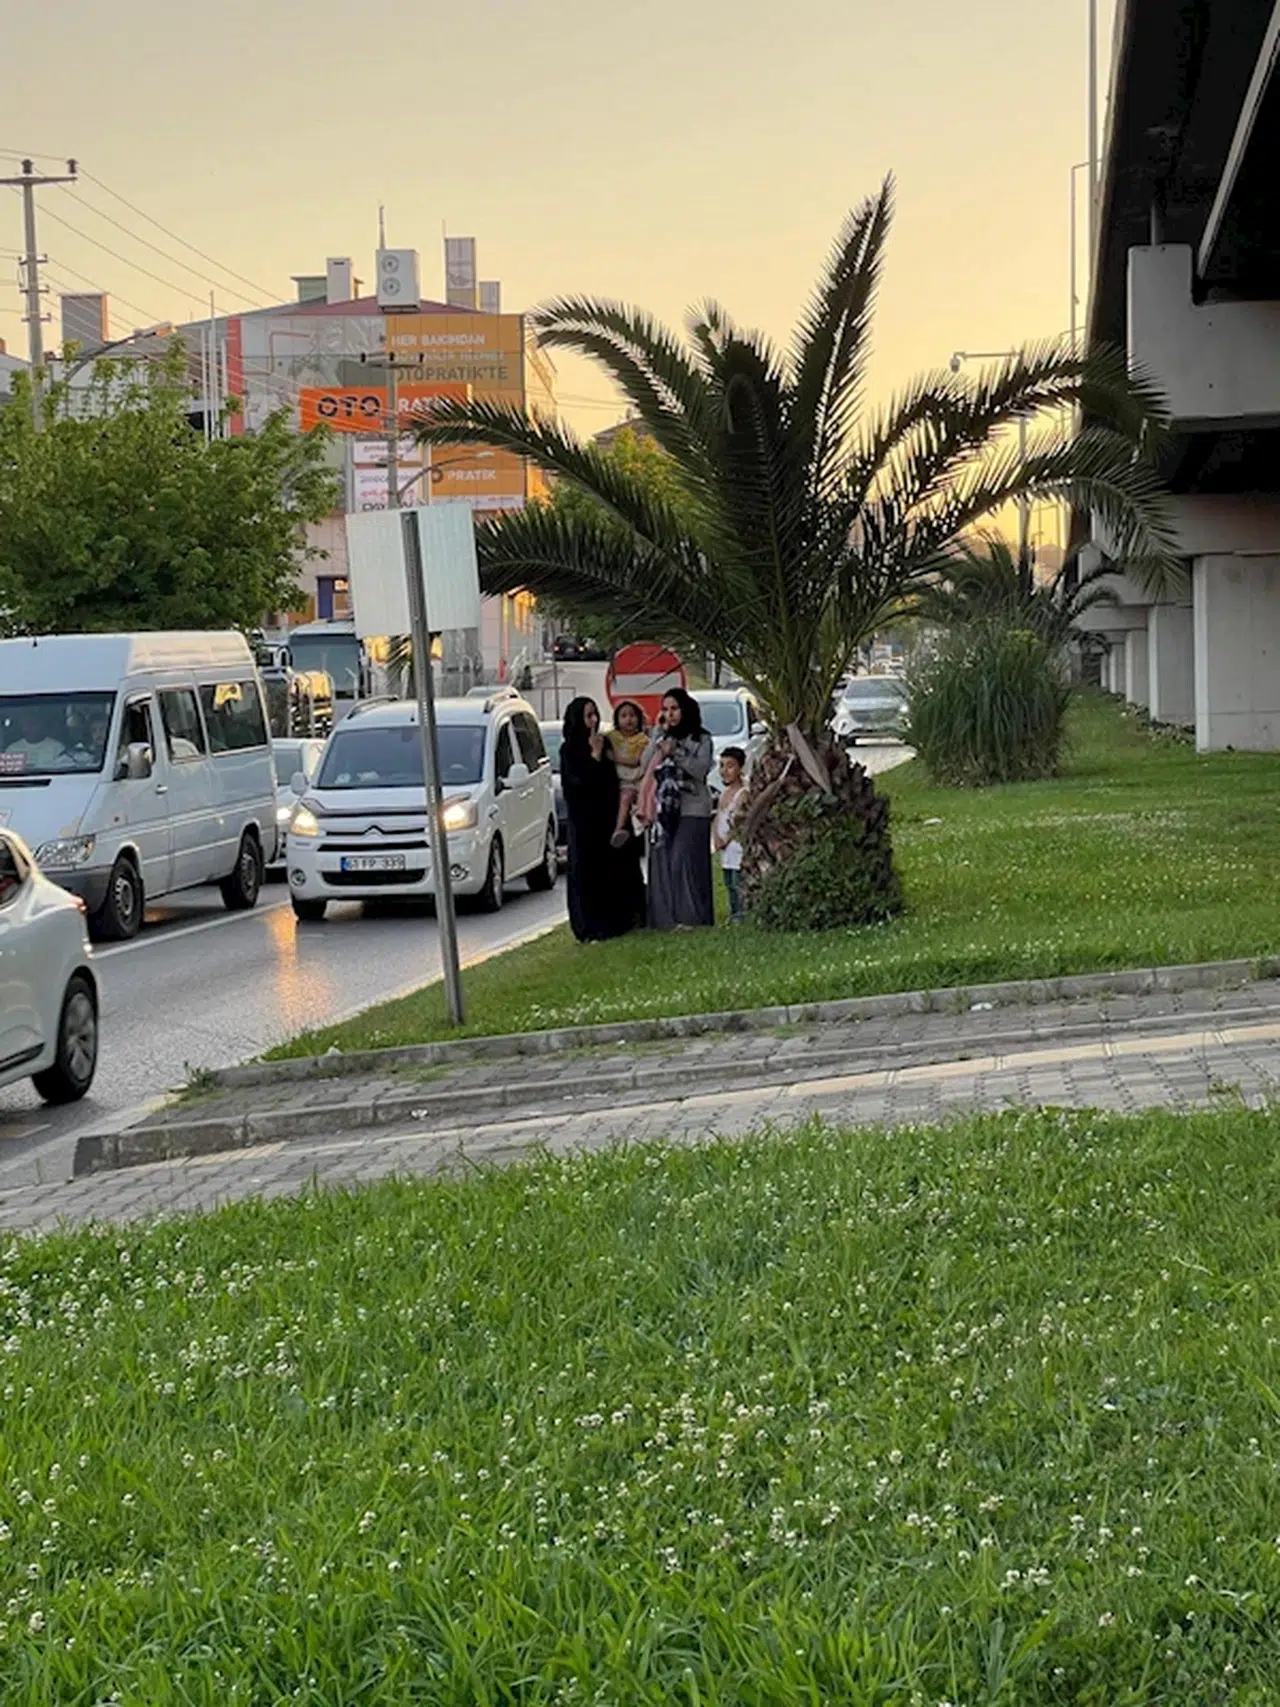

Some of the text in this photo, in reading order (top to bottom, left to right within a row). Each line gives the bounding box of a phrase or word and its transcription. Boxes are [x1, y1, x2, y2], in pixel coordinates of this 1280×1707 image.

[391, 333, 485, 347] HER BAKIMDAN
[317, 395, 381, 417] OTO
[447, 467, 497, 481] PRATİK
